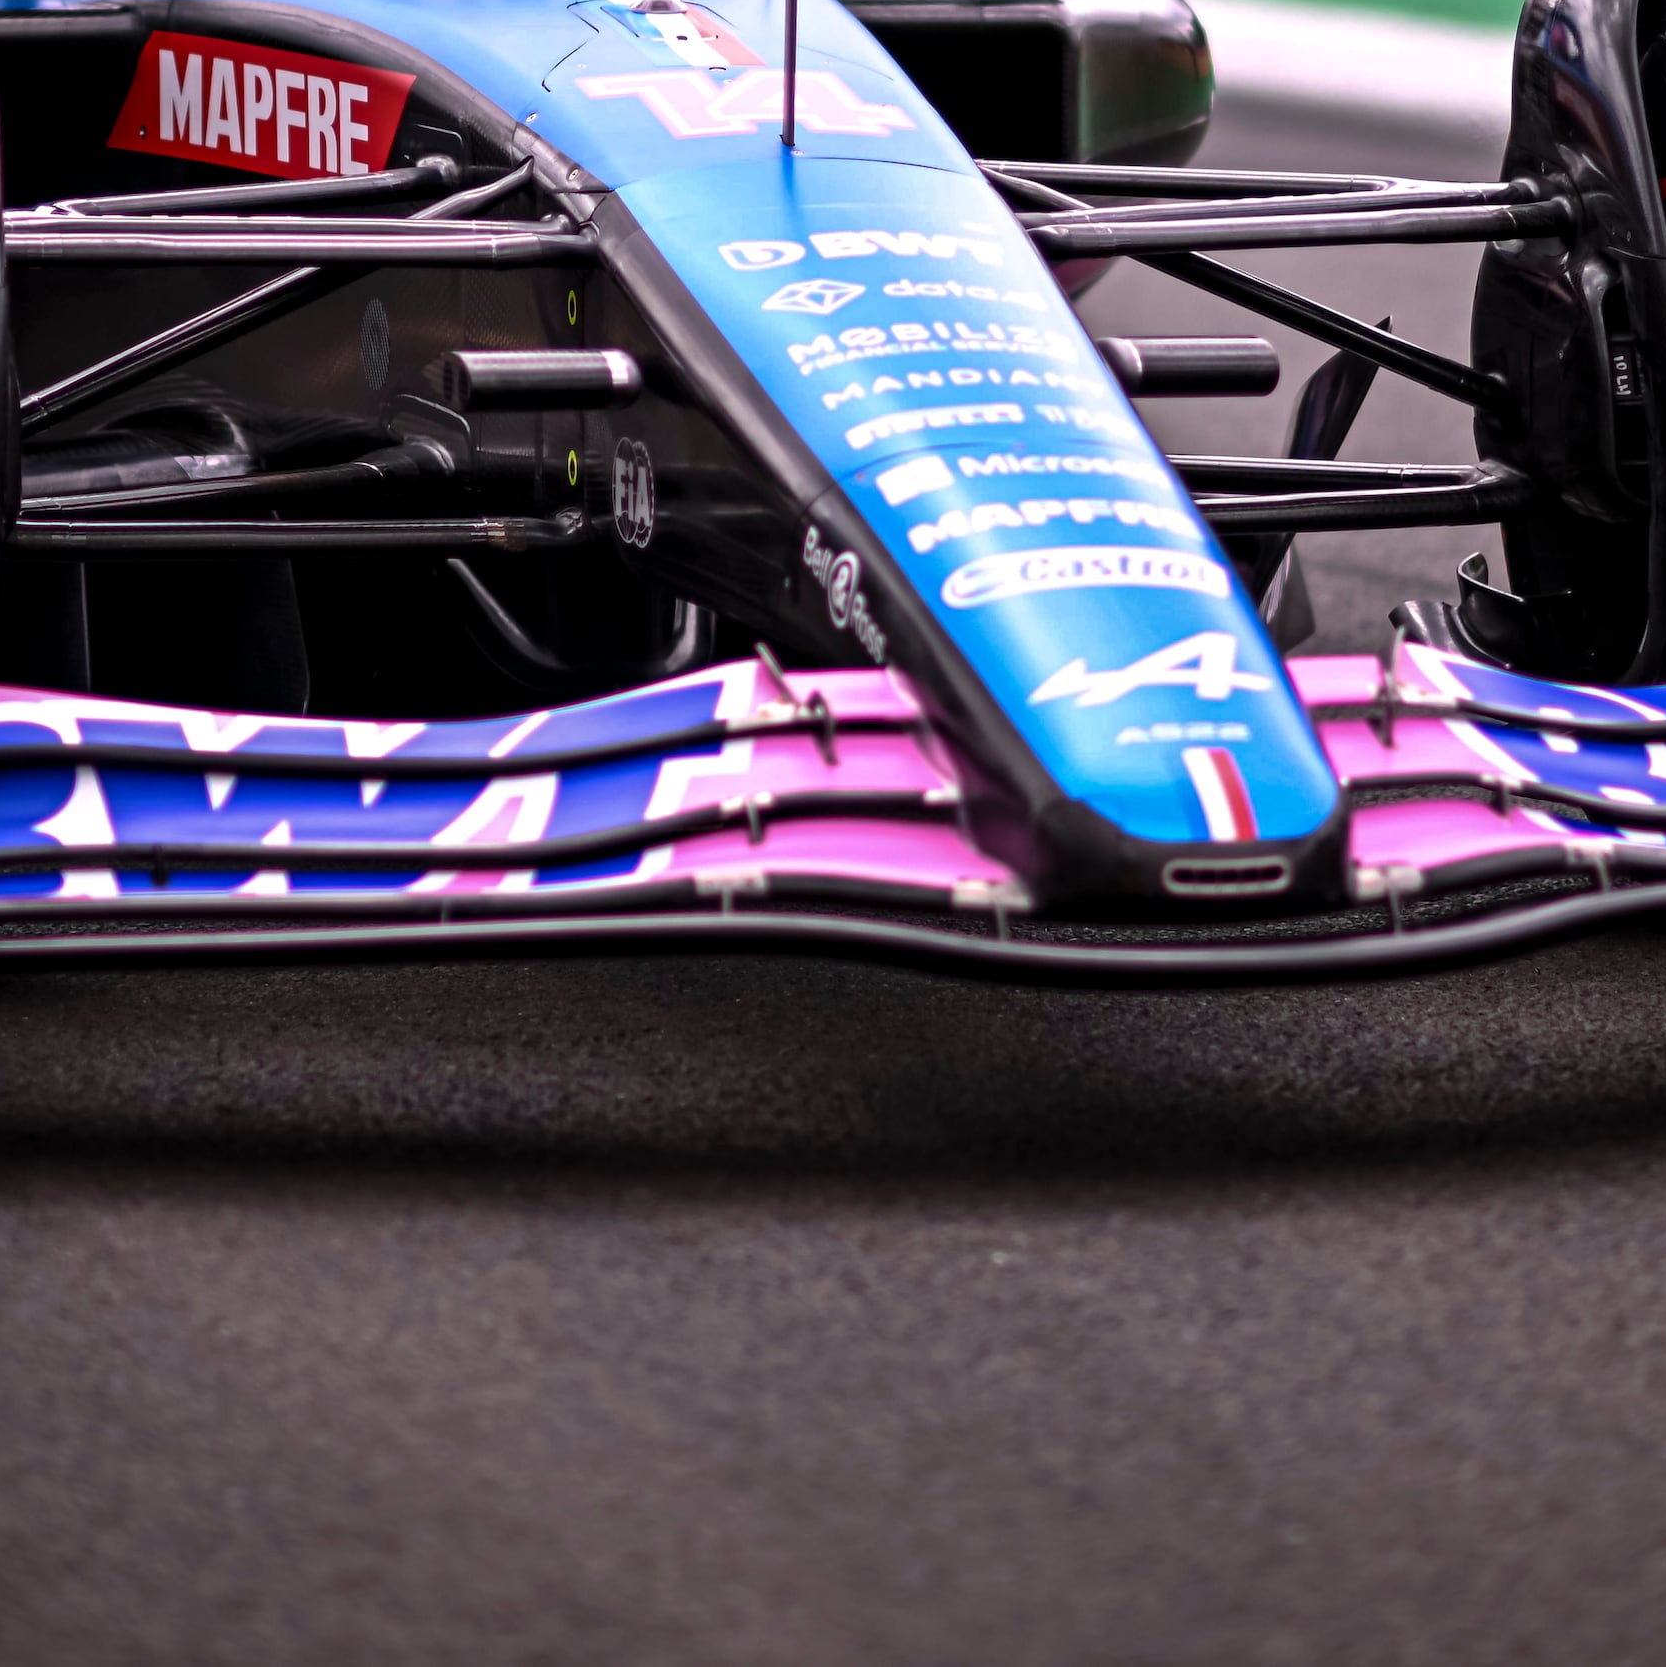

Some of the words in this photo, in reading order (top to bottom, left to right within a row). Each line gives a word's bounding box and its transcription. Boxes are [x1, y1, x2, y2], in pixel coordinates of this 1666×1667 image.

[158, 48, 369, 175] MAPFRE
[809, 230, 1004, 266] BWT
[615, 457, 650, 527] FIA
[803, 525, 832, 588] Bell
[850, 591, 886, 664] Ross
[1020, 554, 1206, 582] Castrol
